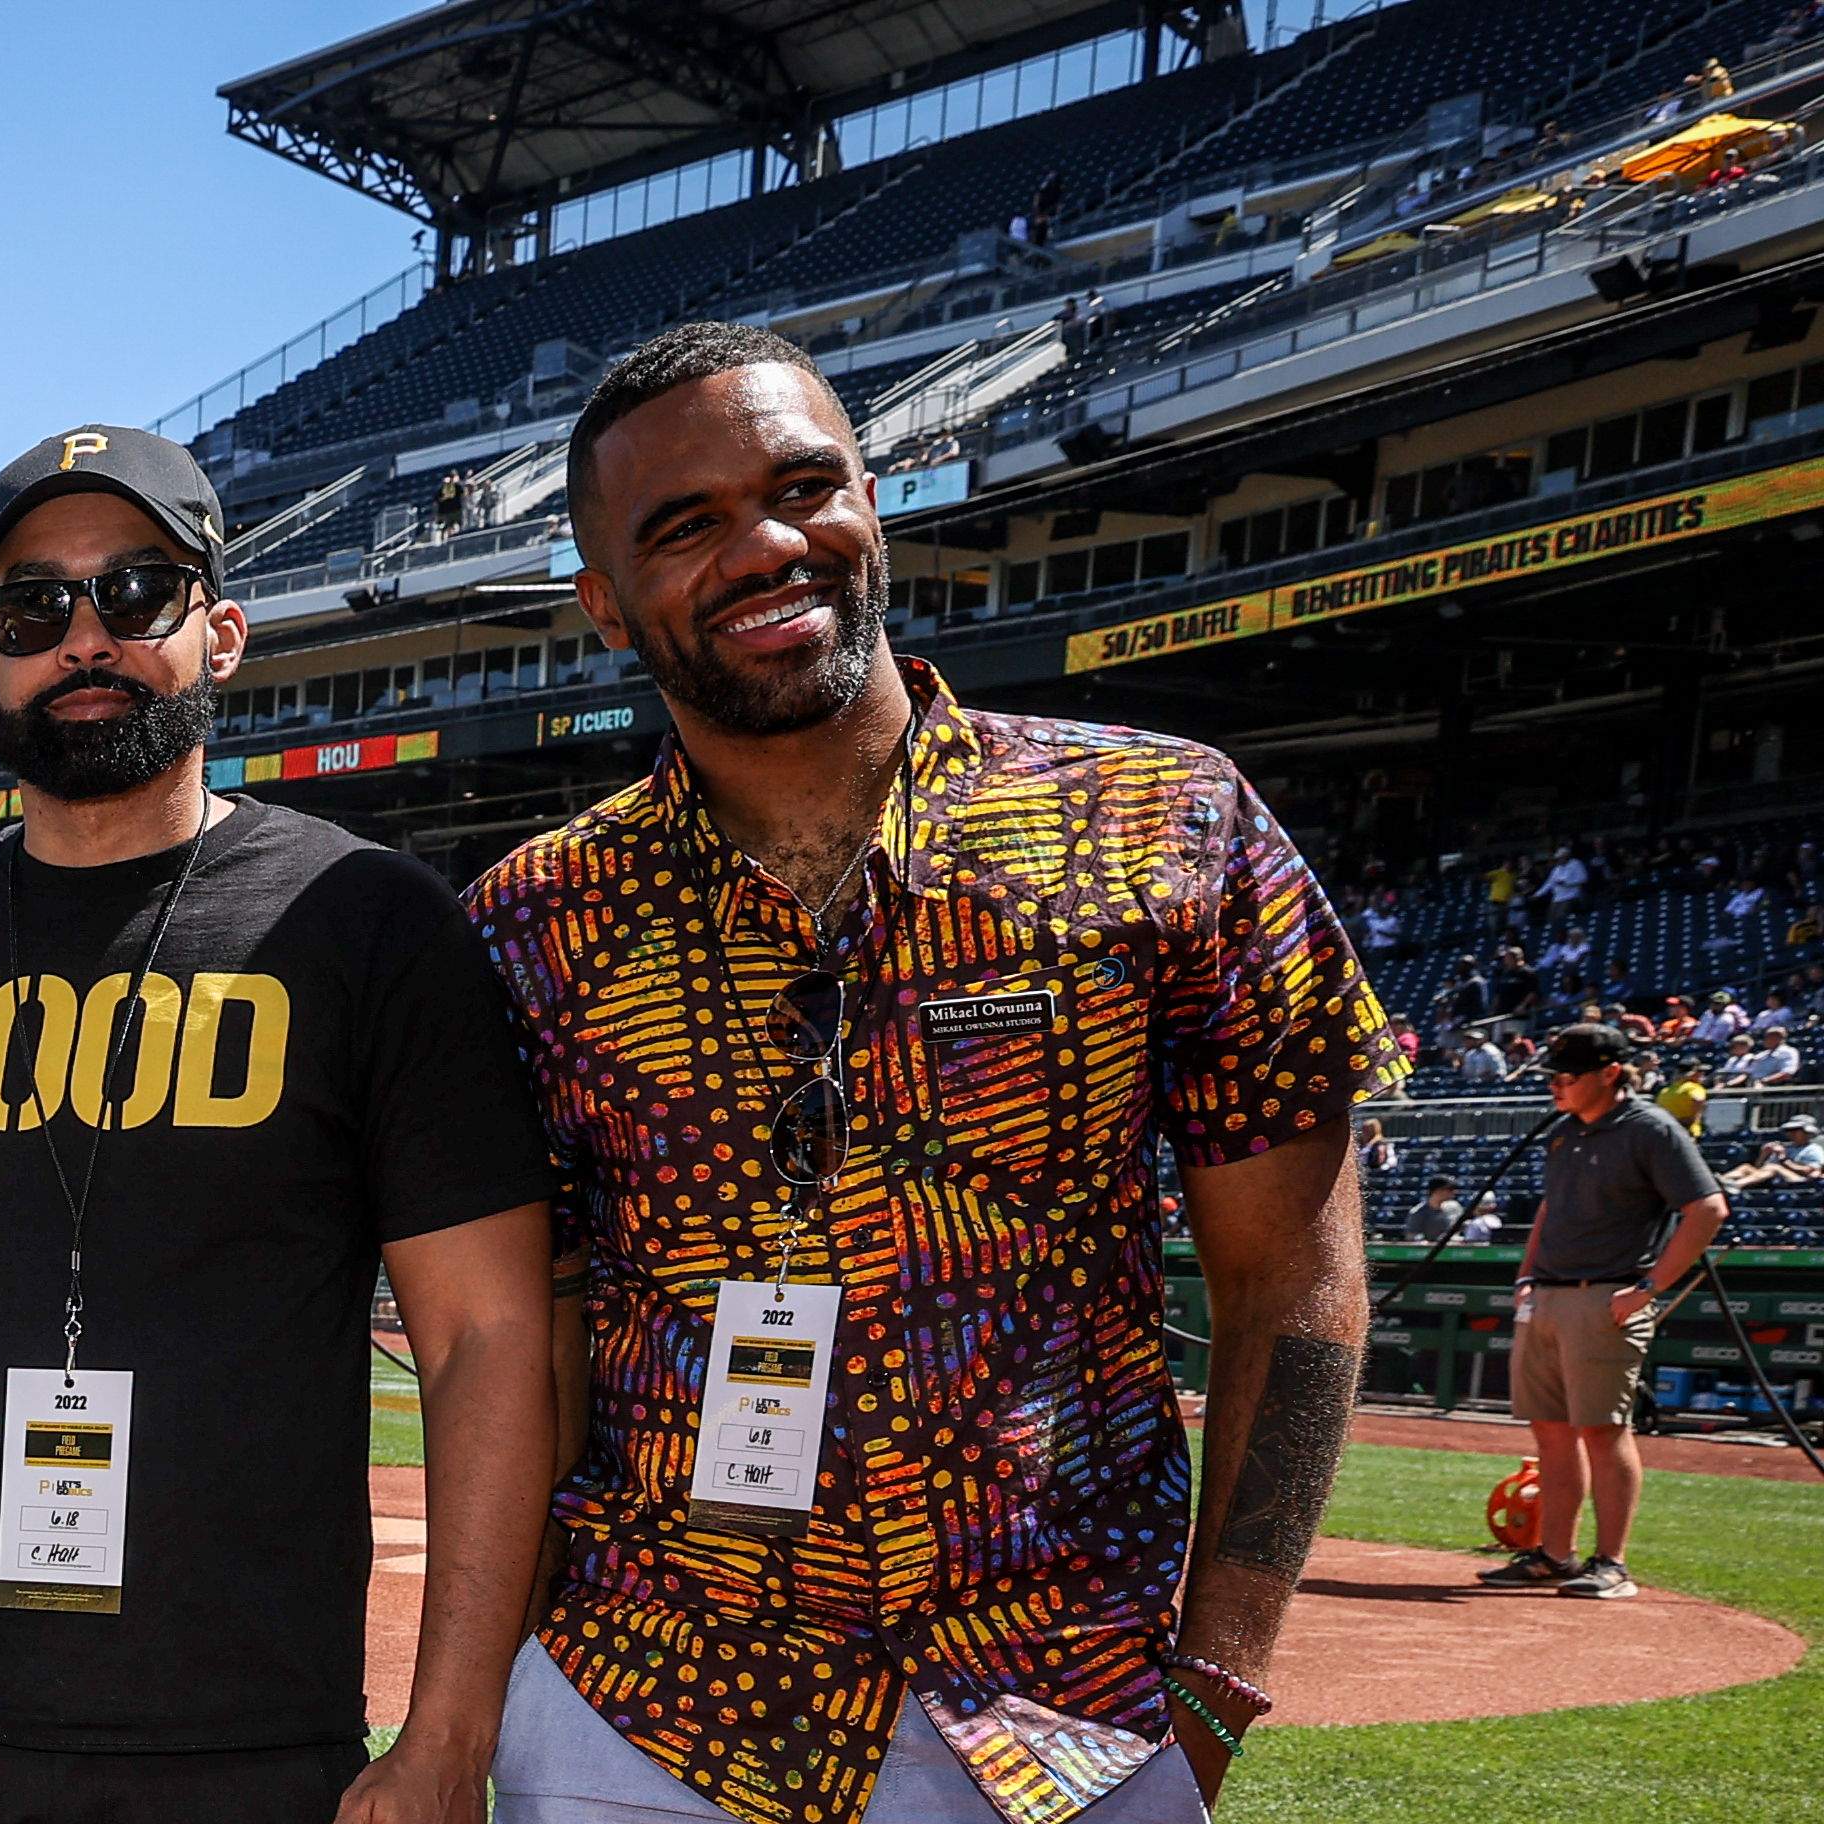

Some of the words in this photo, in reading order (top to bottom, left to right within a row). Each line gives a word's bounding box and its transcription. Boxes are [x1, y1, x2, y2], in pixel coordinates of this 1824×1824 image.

[59, 433, 109, 470] P
[1442, 532, 1551, 585] PIRATES
[1554, 495, 1707, 558] CHARITIES
[1103, 622, 1167, 660] 50/50
[1170, 604, 1241, 645] RAFFLE
[551, 716, 571, 736] SP
[316, 743, 360, 773] HOU
[928, 1004, 978, 1021] Mikael
[982, 1001, 1043, 1016] Owunna
[761, 1309, 794, 1326] 2022
[54, 1394, 87, 1410] 2022
[739, 1397, 750, 1412] P
[756, 1398, 781, 1407] LET'S
[749, 1427, 772, 1445] 6.18
[38, 1480, 50, 1495] P
[56, 1480, 81, 1488] LET'S
[50, 1510, 80, 1526] 6.18
